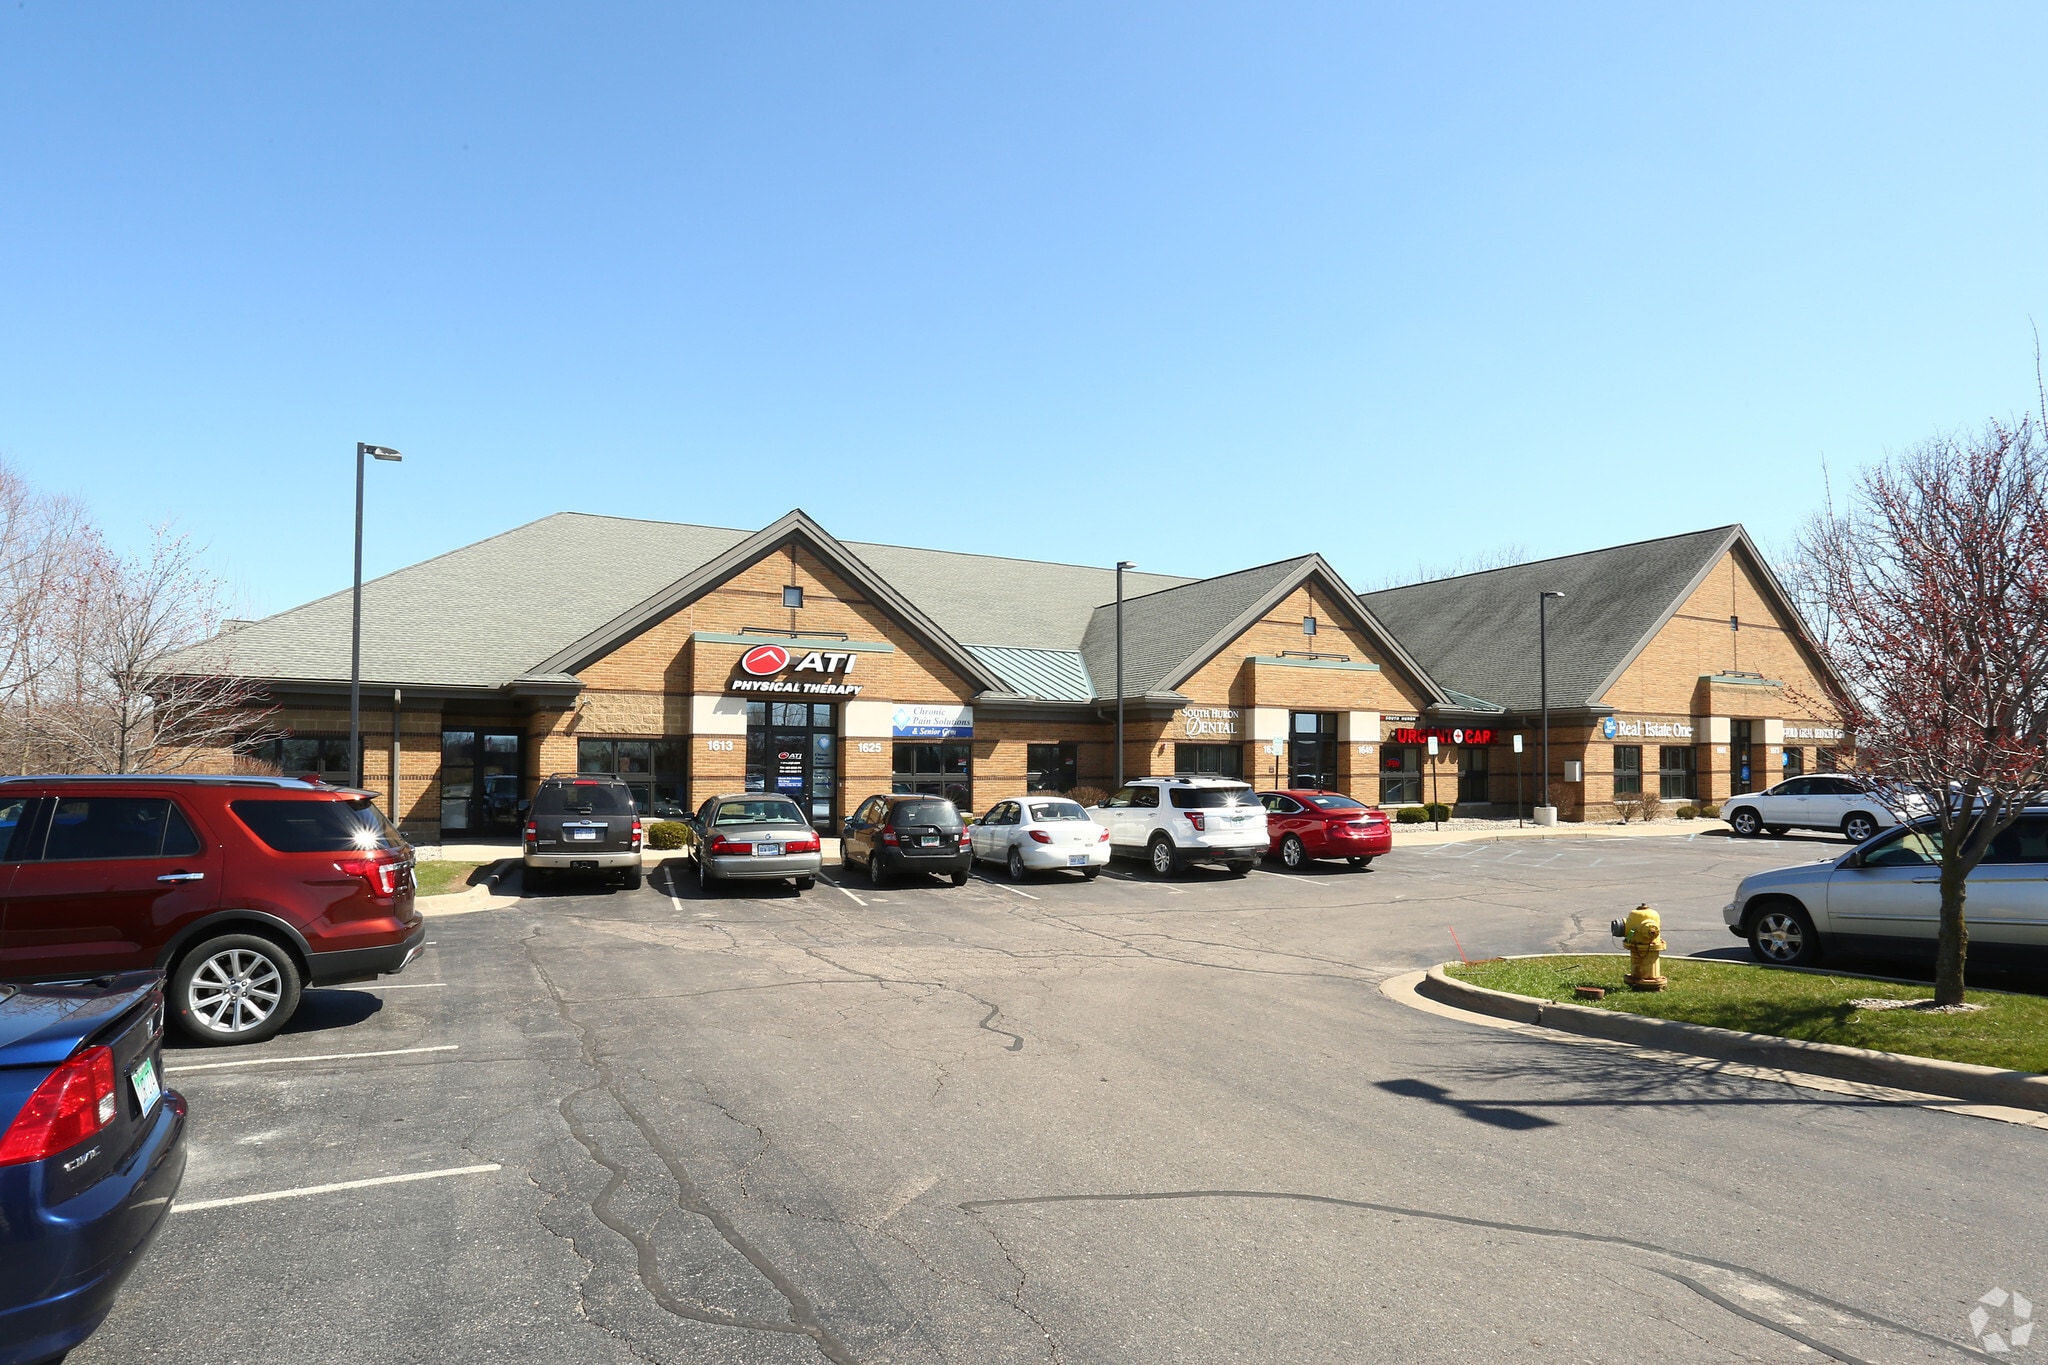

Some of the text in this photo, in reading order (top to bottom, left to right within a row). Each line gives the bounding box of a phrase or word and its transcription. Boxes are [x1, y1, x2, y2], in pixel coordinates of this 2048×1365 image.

[794, 651, 857, 674] ATI
[732, 680, 863, 695] PHYSICAL THERAPY
[913, 706, 947, 716] Chronic
[912, 716, 971, 726] Pain Solutions
[912, 727, 918, 735] &
[919, 727, 941, 735] Senior
[1186, 716, 1238, 738] DENTAL
[1618, 719, 1692, 739] Real Estate One
[707, 740, 734, 751] 1613
[857, 743, 882, 755] 1625
[1358, 745, 1374, 755] 1649
